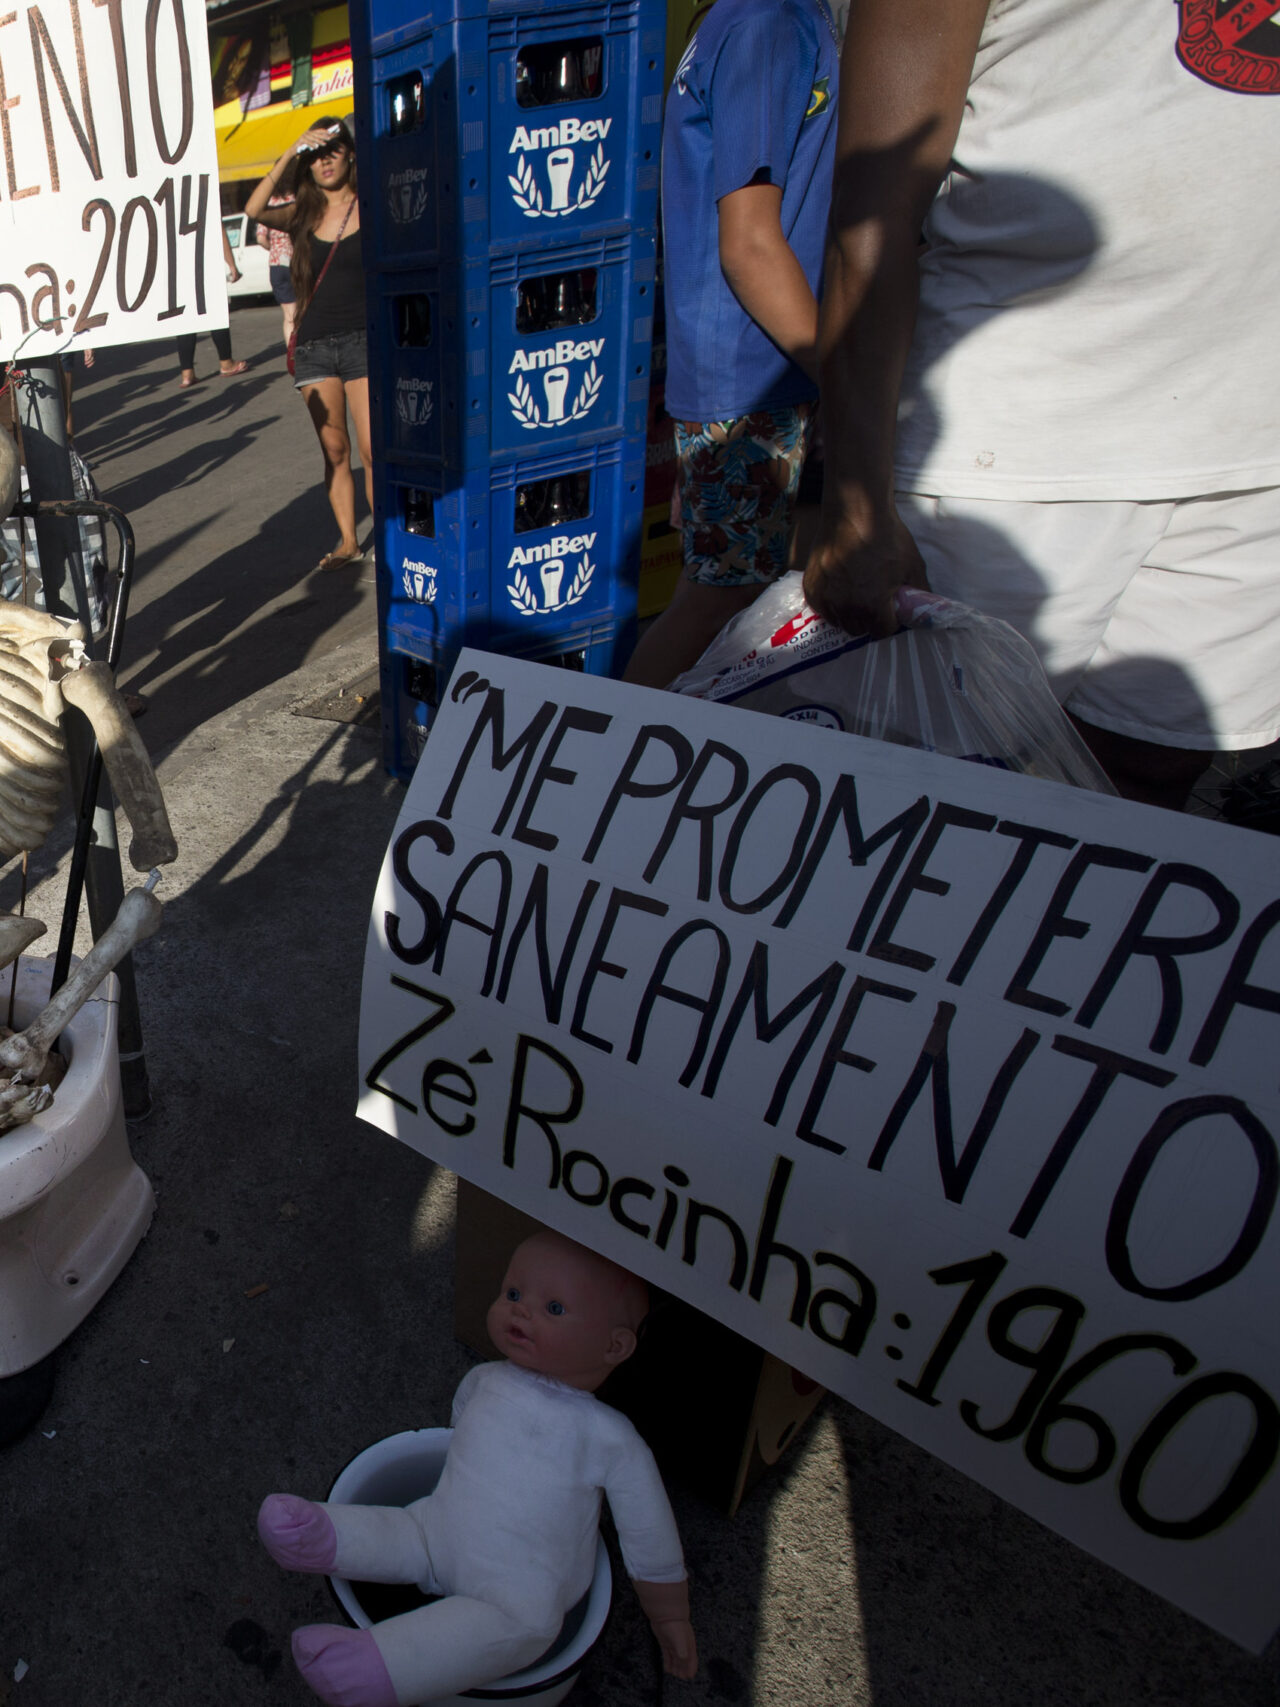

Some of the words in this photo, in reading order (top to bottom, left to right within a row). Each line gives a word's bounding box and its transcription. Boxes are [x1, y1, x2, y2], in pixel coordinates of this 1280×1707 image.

[509, 116, 612, 154] AmBev
[387, 167, 428, 187] AmBev
[507, 337, 606, 375] AmBev
[395, 376, 434, 393] AmBev
[402, 556, 438, 579] AmBev
[506, 531, 599, 570] AmBev
[365, 973, 493, 1137] Zé
[384, 820, 1280, 1303] SANEAMENTO
